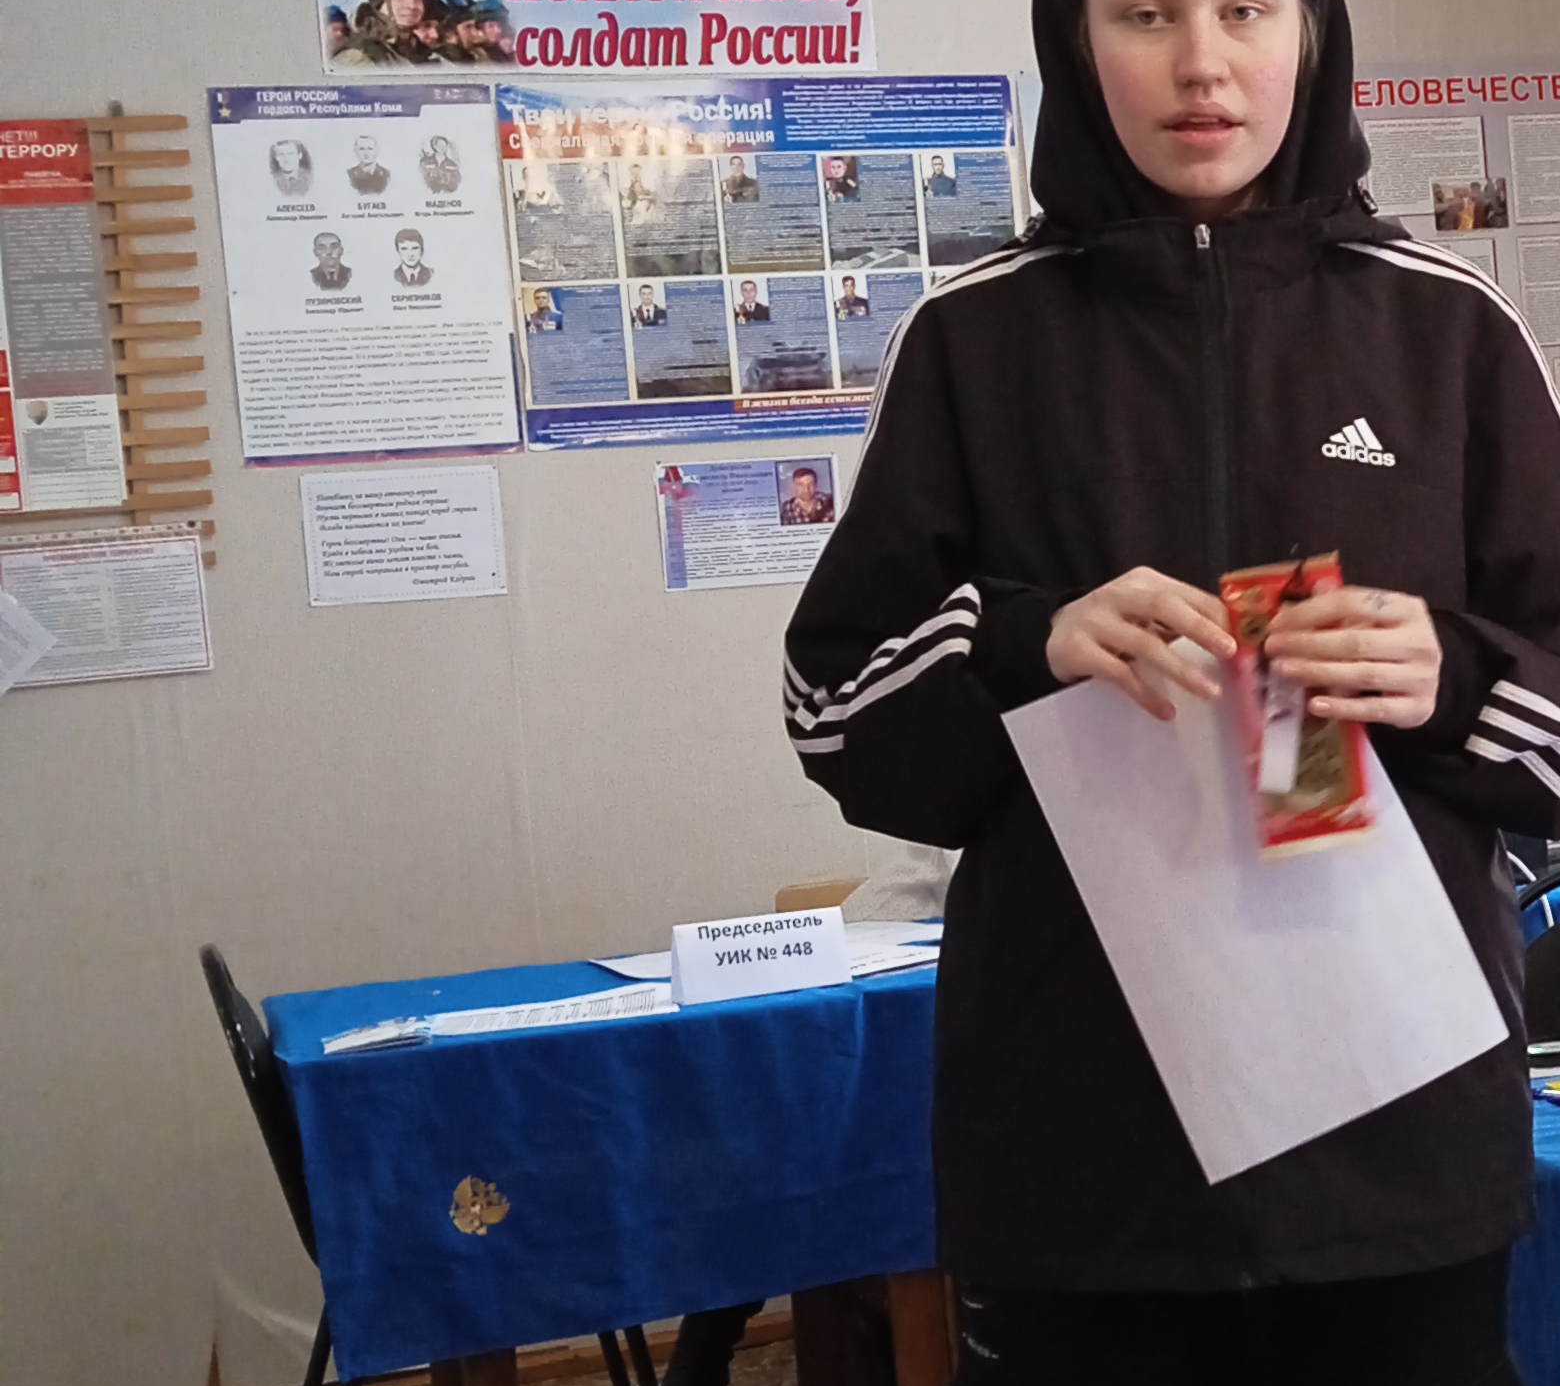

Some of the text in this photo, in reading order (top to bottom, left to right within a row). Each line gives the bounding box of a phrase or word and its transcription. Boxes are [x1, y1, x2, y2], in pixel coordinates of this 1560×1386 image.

[515, 11, 863, 68] солдат России!
[256, 91, 291, 102] ГЕРОИ
[294, 90, 339, 102] РОССИИ
[309, 103, 372, 115] Республики
[672, 97, 773, 122] Россия!
[1321, 442, 1396, 467] adidas
[697, 914, 823, 942] Председатель
[715, 941, 814, 966] УИК № 448
